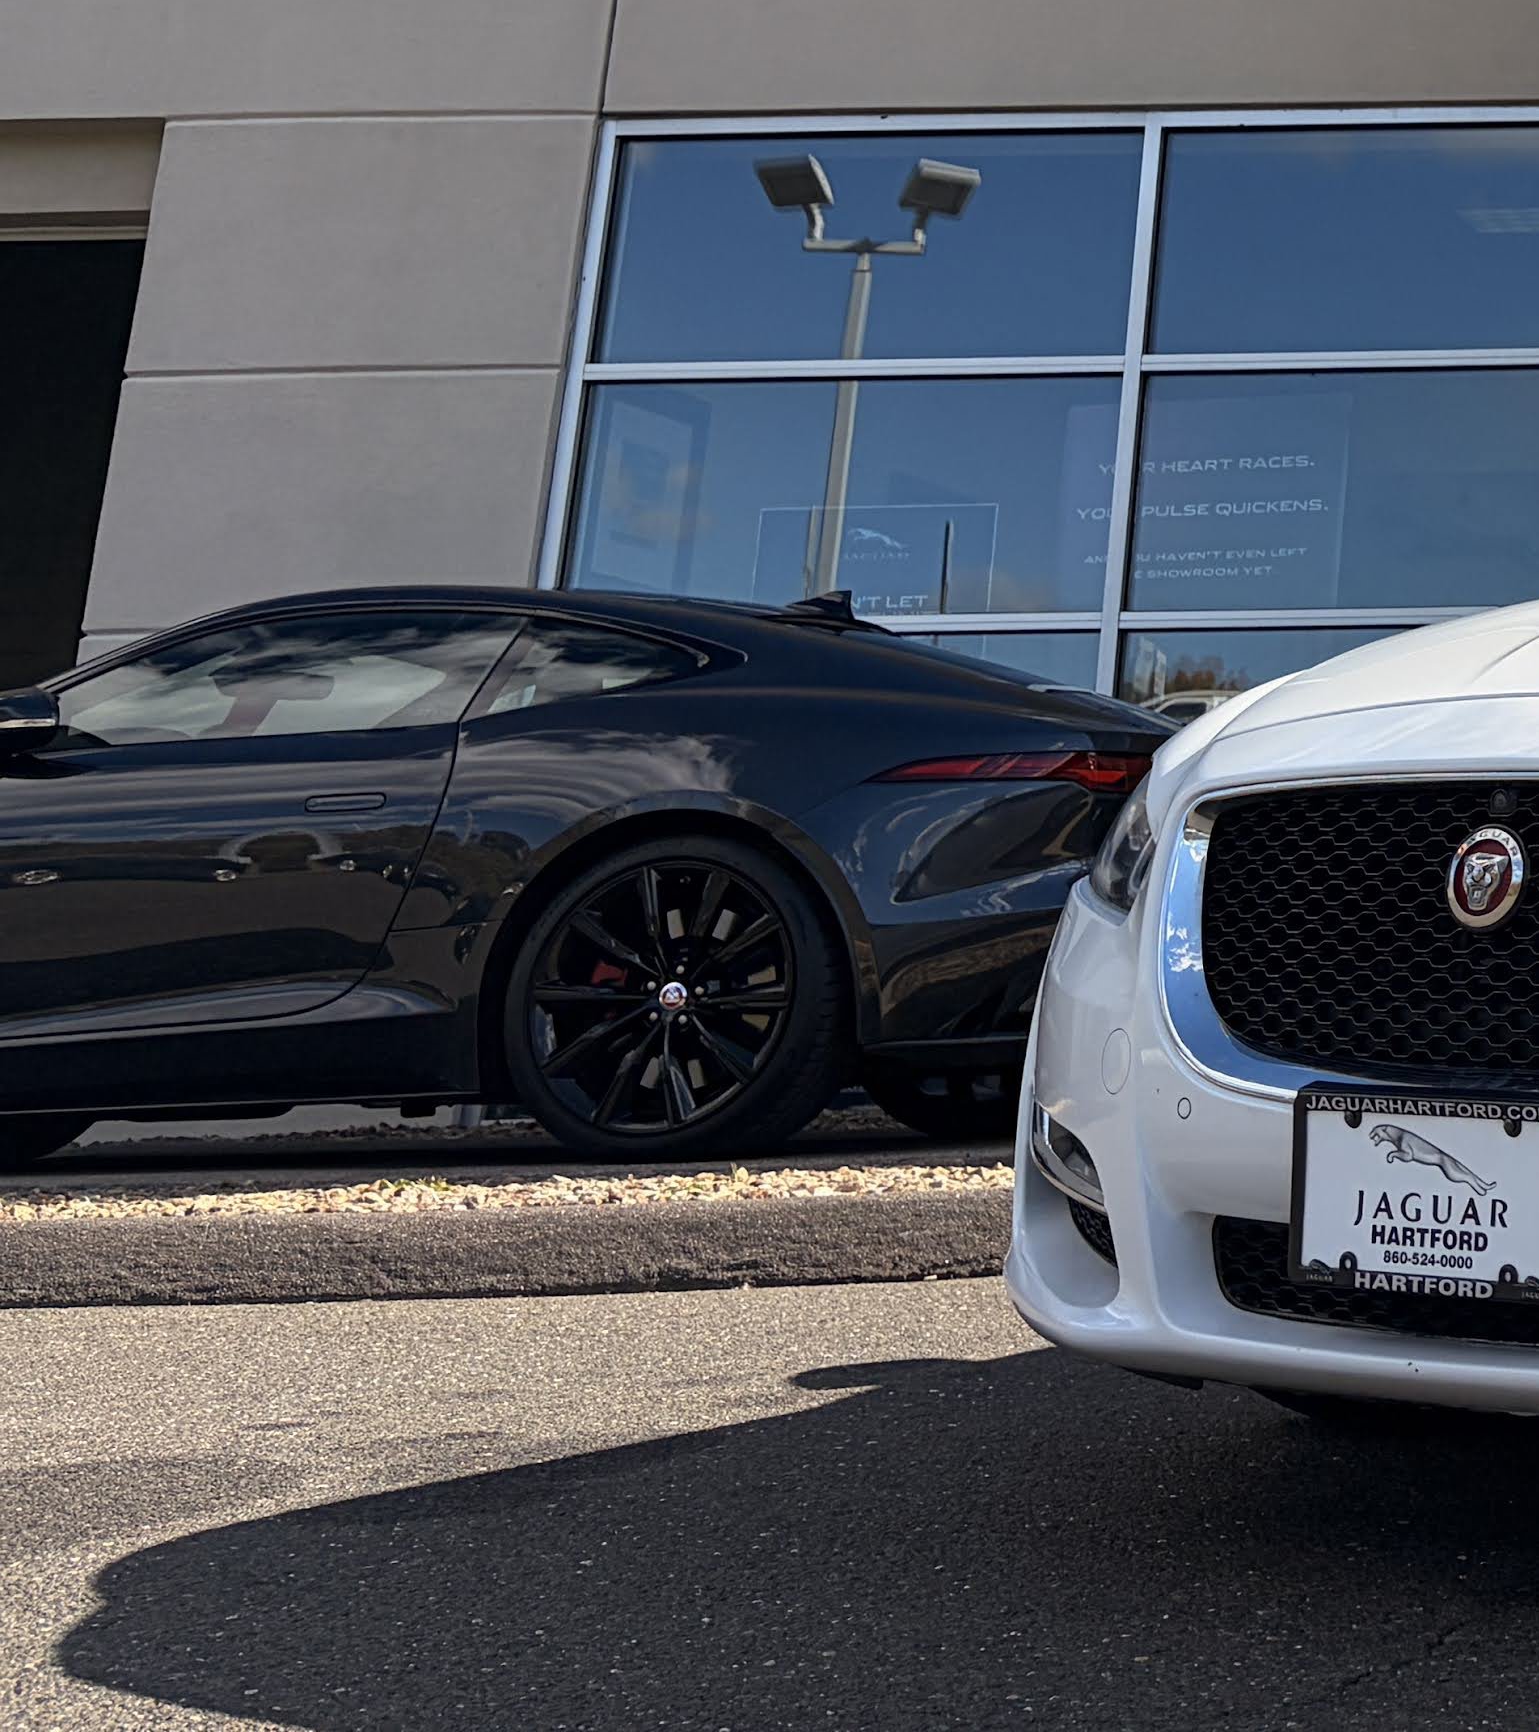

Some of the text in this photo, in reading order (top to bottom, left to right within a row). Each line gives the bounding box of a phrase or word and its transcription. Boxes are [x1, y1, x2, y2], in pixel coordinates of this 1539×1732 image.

[1099, 455, 1315, 475] YR HEART RACES.
[1141, 504, 1209, 518] PULSE
[1215, 499, 1328, 516] QUICKENS.
[1084, 555, 1109, 564] AN
[1156, 550, 1222, 562] HAVEN'T
[1226, 548, 1265, 560] EVEN
[1270, 547, 1307, 558] LEFT
[1147, 567, 1239, 579] SHOWROOM
[851, 595, 929, 609] N'T LET
[1353, 1190, 1508, 1228] JAGUAR
[1371, 1225, 1488, 1252] HARTFORD
[1383, 1250, 1473, 1269] 860-524-0000
[1354, 1271, 1494, 1299] HARTFORD
